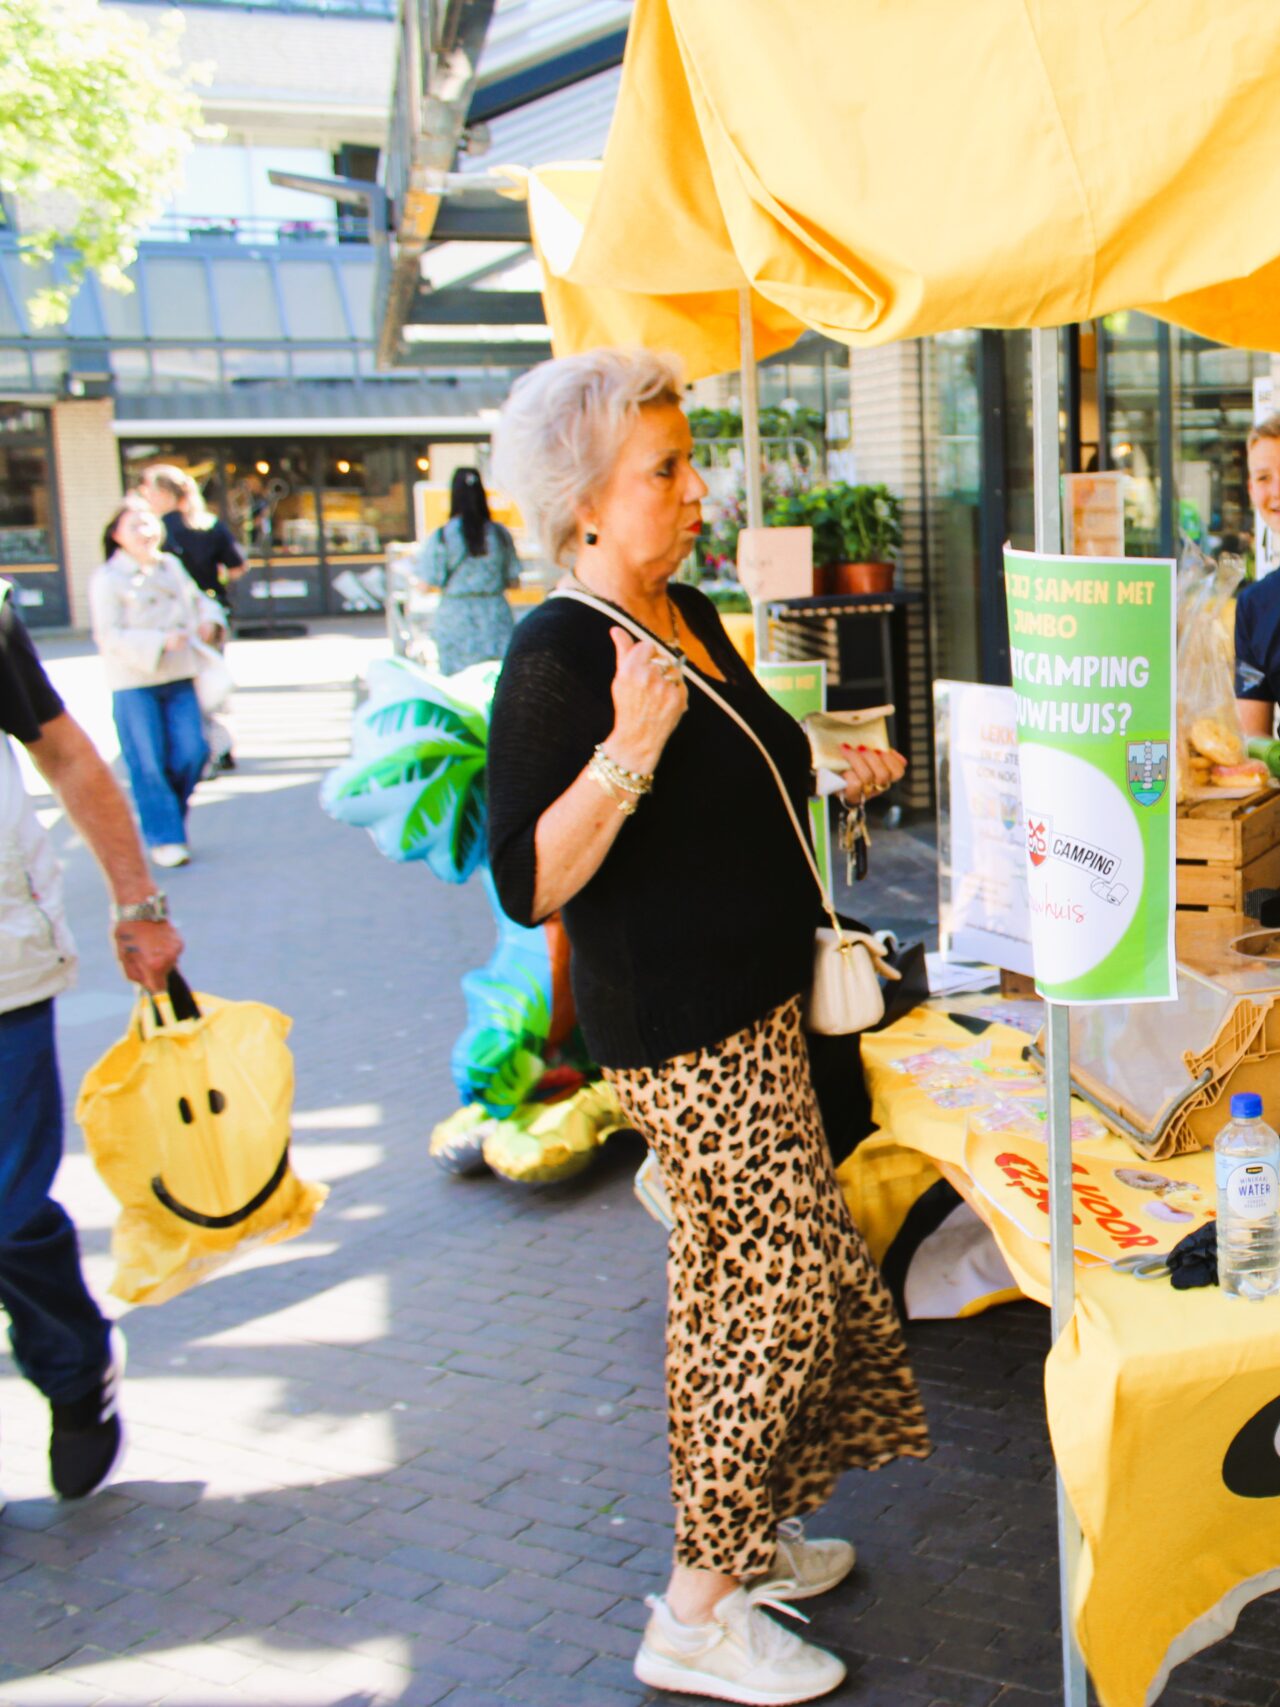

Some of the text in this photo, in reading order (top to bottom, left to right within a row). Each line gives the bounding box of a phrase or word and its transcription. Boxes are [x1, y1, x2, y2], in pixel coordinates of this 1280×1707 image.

[1034, 577, 1109, 604] SAMEN
[1117, 580, 1155, 605] MET
[1014, 608, 1077, 639] JUMBO
[1016, 694, 1133, 736] UWHUIS?
[1053, 838, 1115, 876] CAMPING
[1238, 1183, 1271, 1197] WATER
